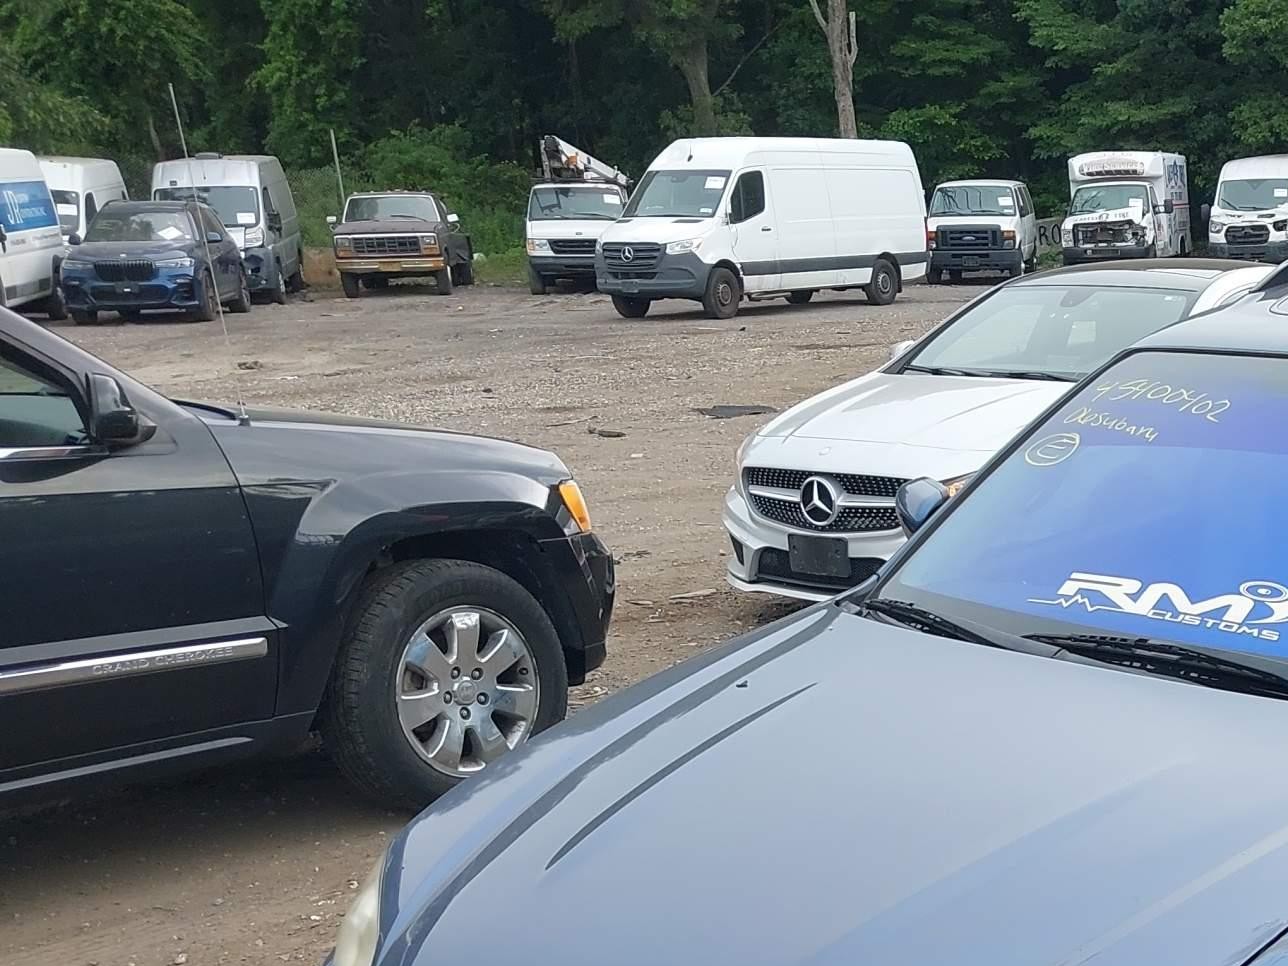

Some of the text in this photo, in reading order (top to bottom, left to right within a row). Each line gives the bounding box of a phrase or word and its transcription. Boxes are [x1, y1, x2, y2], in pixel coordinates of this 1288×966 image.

[1092, 379, 1231, 422] 45400402
[1147, 609, 1280, 641] CUSTOMS
[93, 647, 233, 675] GRAND CHEROKEE
